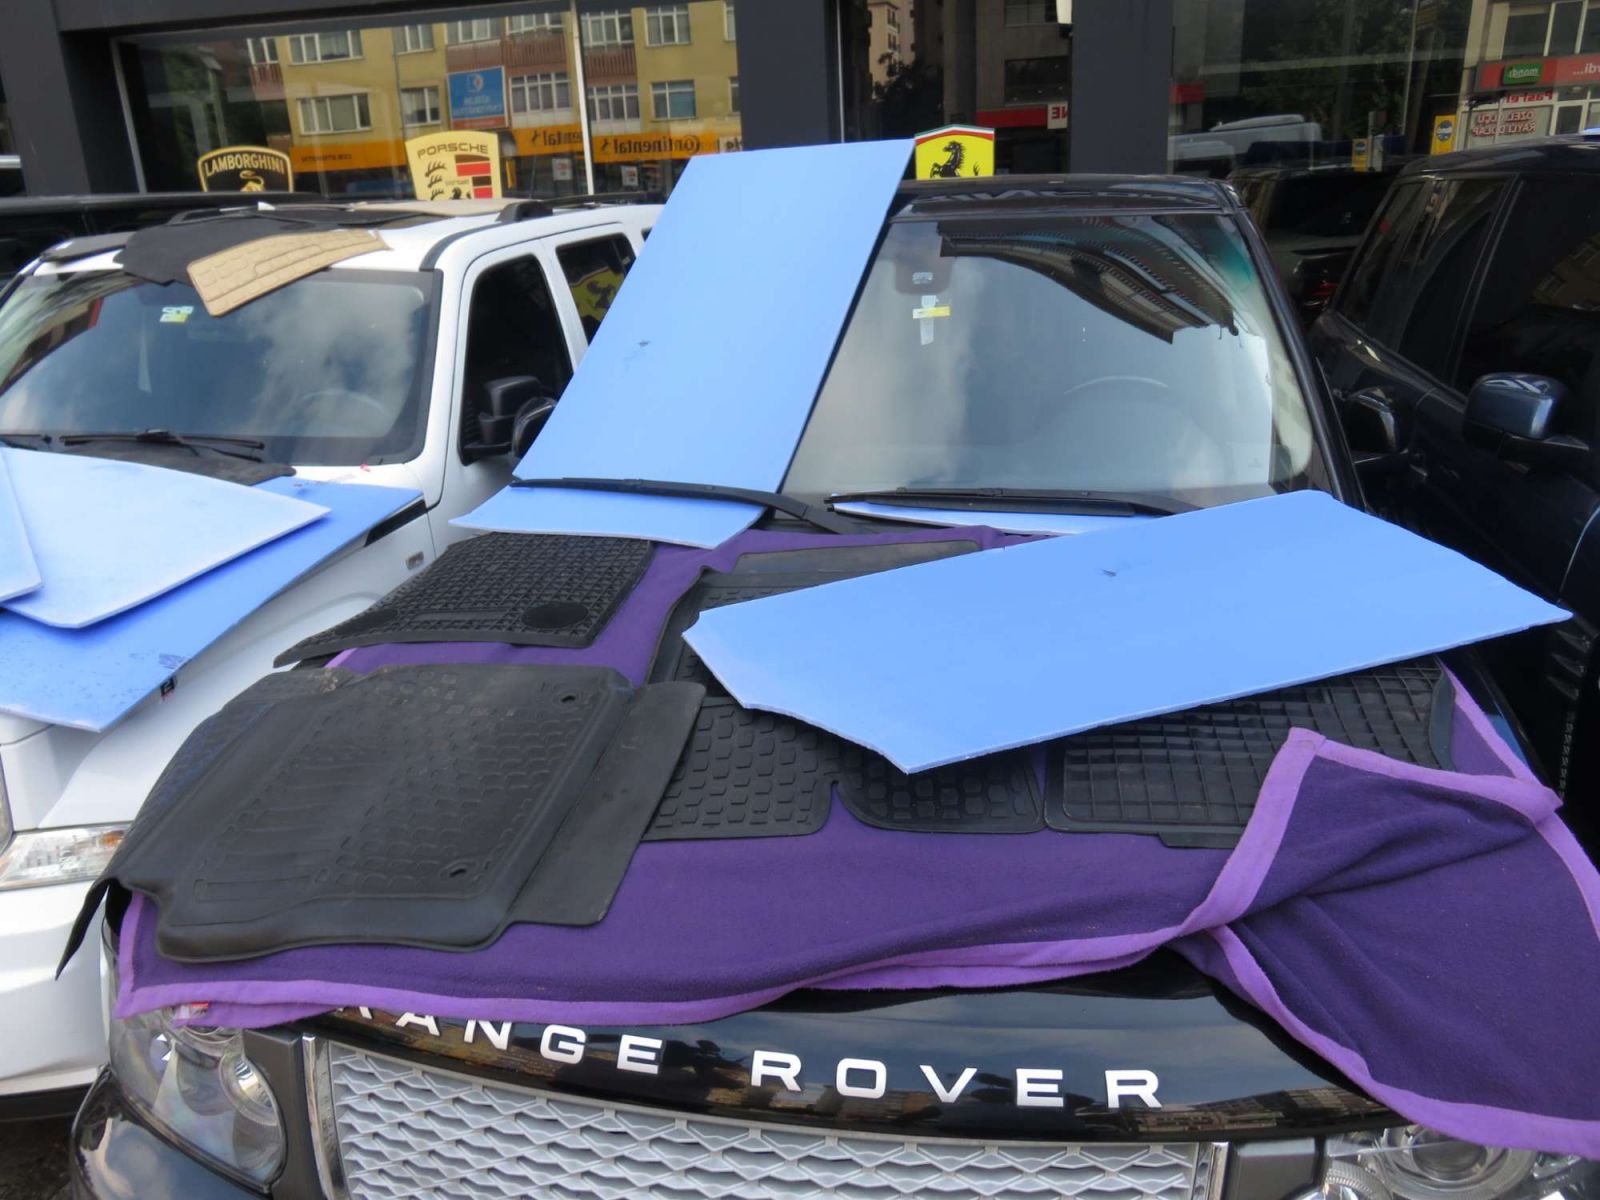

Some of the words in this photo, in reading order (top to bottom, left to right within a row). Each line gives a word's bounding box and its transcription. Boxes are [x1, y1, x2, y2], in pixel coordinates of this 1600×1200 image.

[417, 142, 489, 159] PORSCHE
[204, 153, 285, 177] LAMBORGHINI
[337, 1005, 663, 1075] ANGE
[751, 1049, 1162, 1109] ROVER
